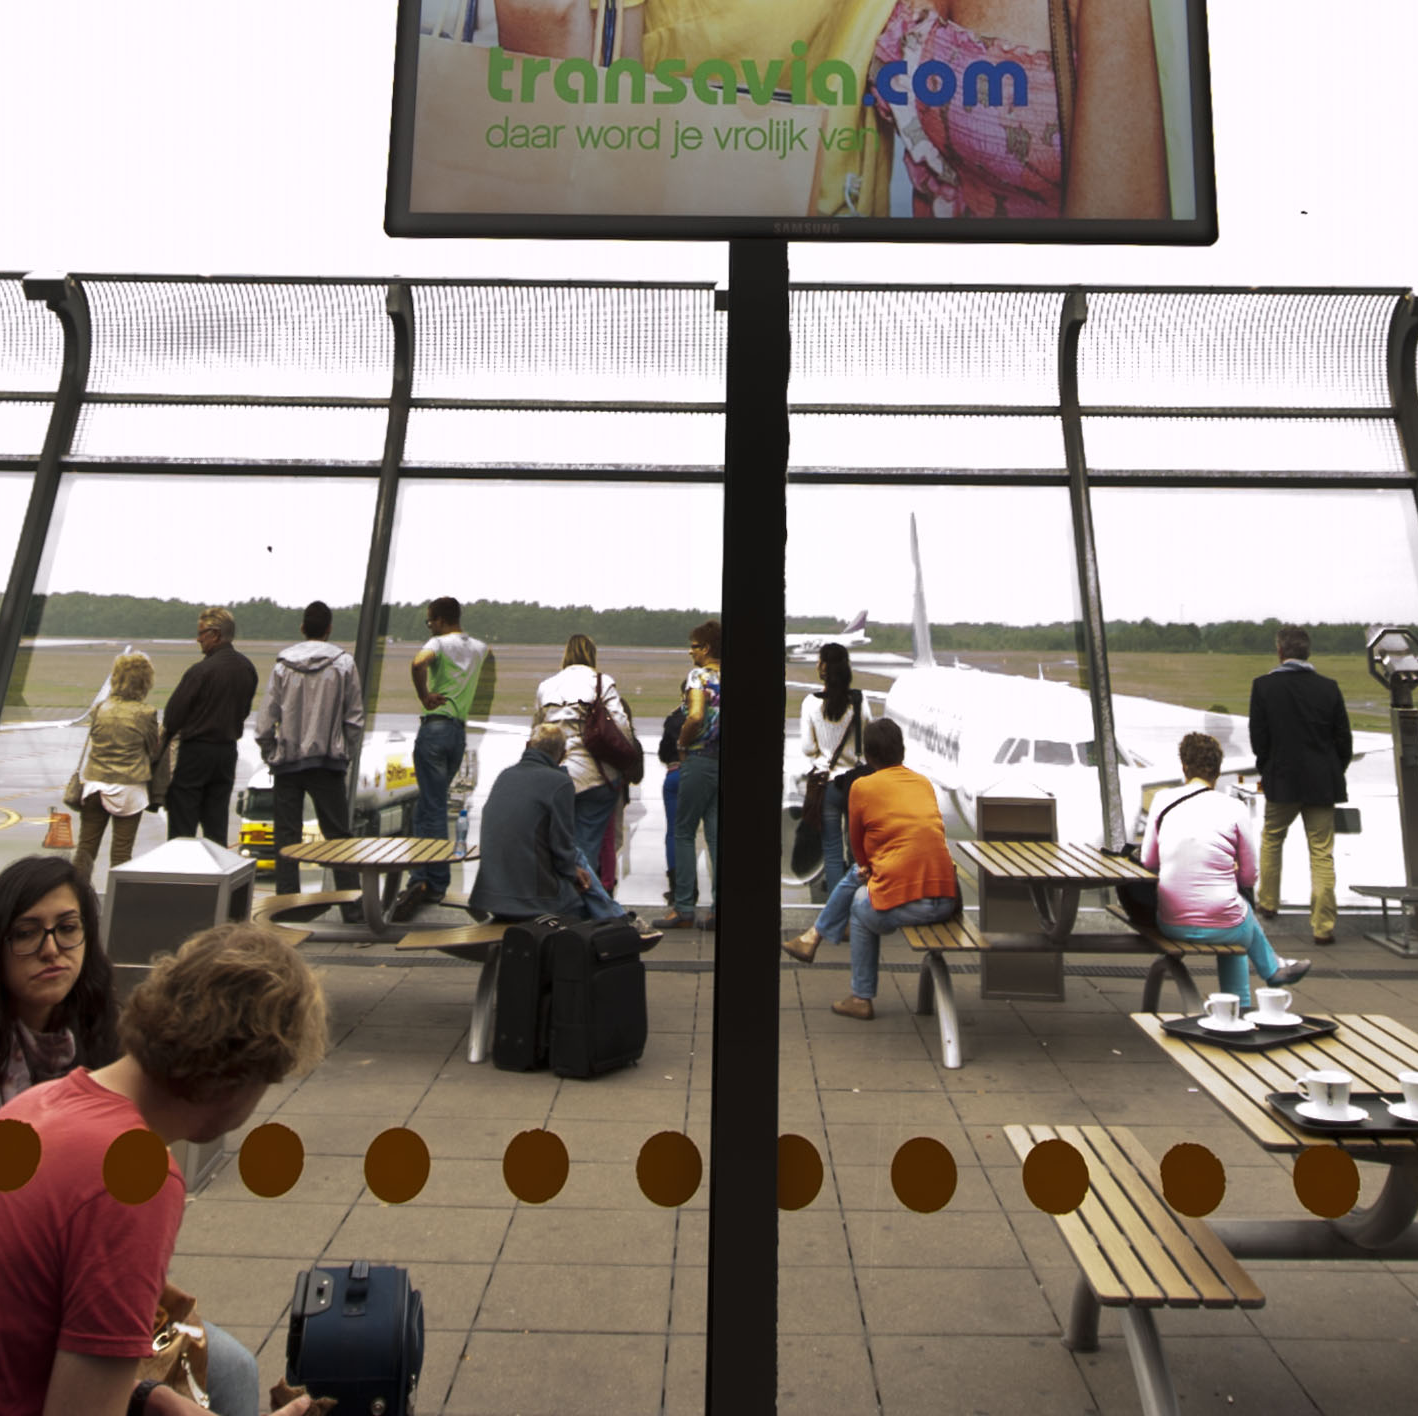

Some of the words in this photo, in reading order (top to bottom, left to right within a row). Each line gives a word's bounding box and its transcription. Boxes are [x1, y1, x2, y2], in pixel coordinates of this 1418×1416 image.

[486, 39, 1029, 108] transavia.com
[485, 115, 566, 149] daar
[575, 117, 661, 151] word
[670, 119, 703, 160] je
[713, 118, 809, 161] vrolijk
[818, 126, 880, 153] van
[772, 221, 841, 235] SAMSUNG
